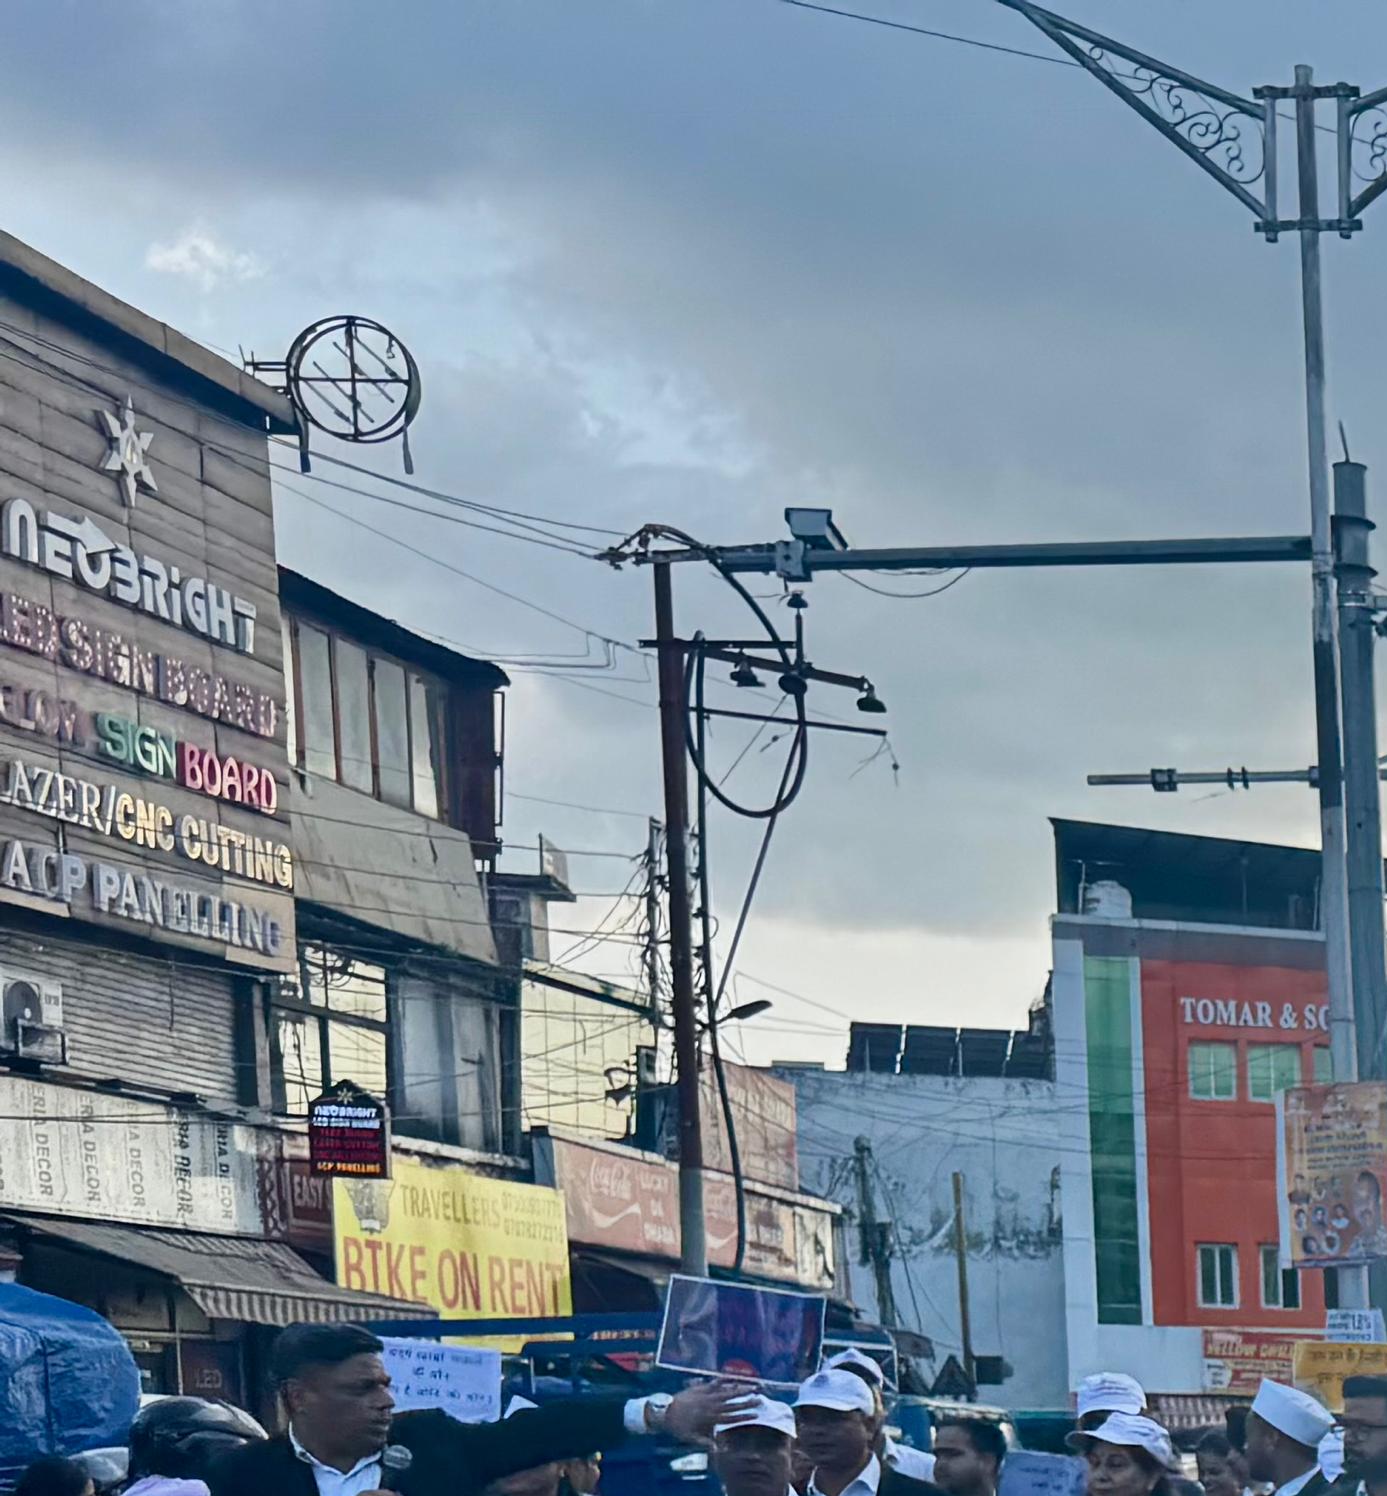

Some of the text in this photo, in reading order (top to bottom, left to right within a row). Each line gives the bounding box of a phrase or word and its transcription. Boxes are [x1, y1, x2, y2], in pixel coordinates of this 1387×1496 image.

[61, 613, 156, 694] SIGN
[96, 711, 177, 780] SIGN
[177, 741, 277, 816] BOARD
[2, 840, 88, 902] ACP
[175, 813, 293, 889] CUTTING
[1180, 996, 1274, 1028] TOMAR
[1279, 1002, 1298, 1029] &
[35, 1133, 53, 1196] DECOR
[82, 1140, 101, 1202] DECOR
[128, 1148, 146, 1208] DECOR
[399, 1183, 500, 1229] TRAVELLERS
[437, 1250, 481, 1312] ON
[488, 1255, 568, 1317] RENT
